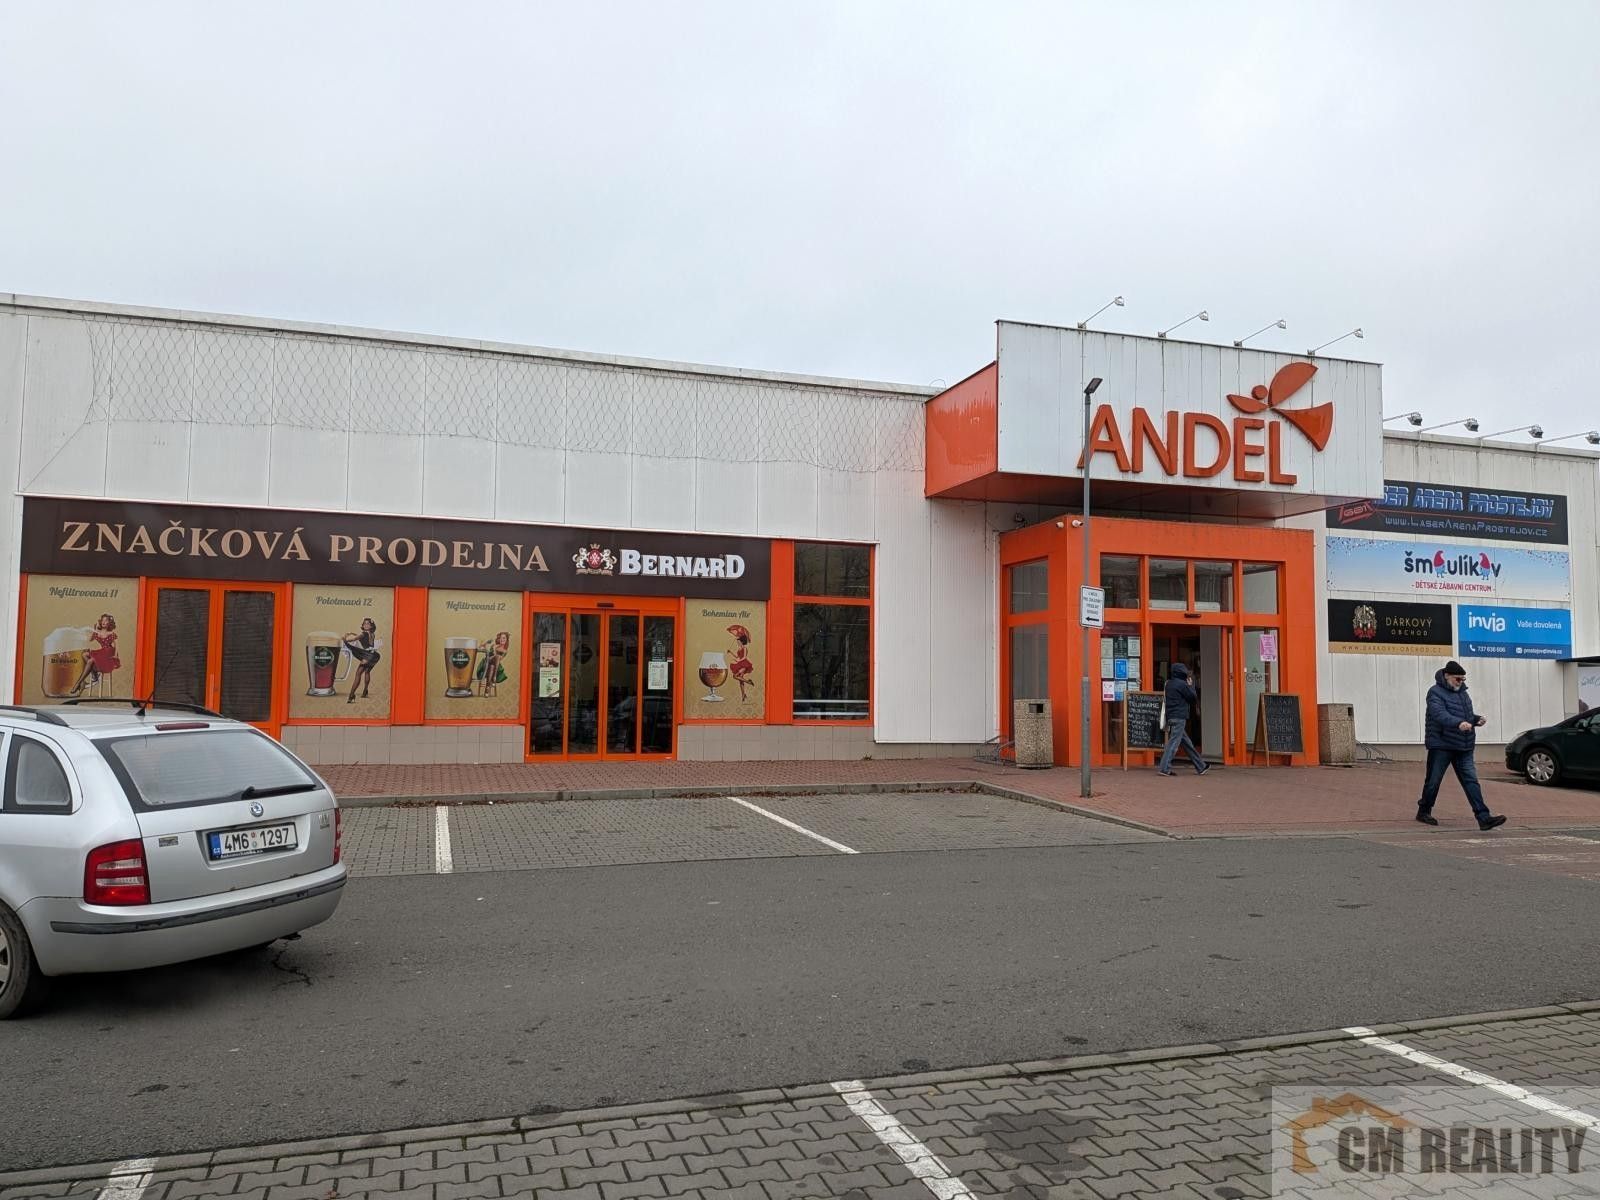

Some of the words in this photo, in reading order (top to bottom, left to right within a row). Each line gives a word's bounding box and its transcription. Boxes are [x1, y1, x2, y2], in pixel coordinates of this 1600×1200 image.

[1413, 488, 1463, 511] ARENA
[60, 520, 311, 561] ZNAČKOVÁ
[329, 534, 550, 572] PRODEJNA
[619, 548, 745, 579] BERNARD
[1415, 580, 1438, 590] DĚTSKÉ
[1439, 582, 1464, 591] ZÁBAVNÍ
[1465, 584, 1492, 592] CENTRUM
[49, 587, 108, 598] Nefiltrovaná
[110, 589, 119, 598] 11
[315, 596, 361, 606] Polotmavá
[363, 598, 373, 606] 12
[497, 603, 506, 611] 12
[702, 609, 737, 618] Bohemian
[1385, 615, 1433, 628] DÁRKOVÝ
[1468, 612, 1505, 632] invia
[1516, 619, 1532, 629] Vaše
[1533, 620, 1562, 630] dovolená
[224, 833, 250, 852] 4M6
[259, 827, 290, 847] 1297
